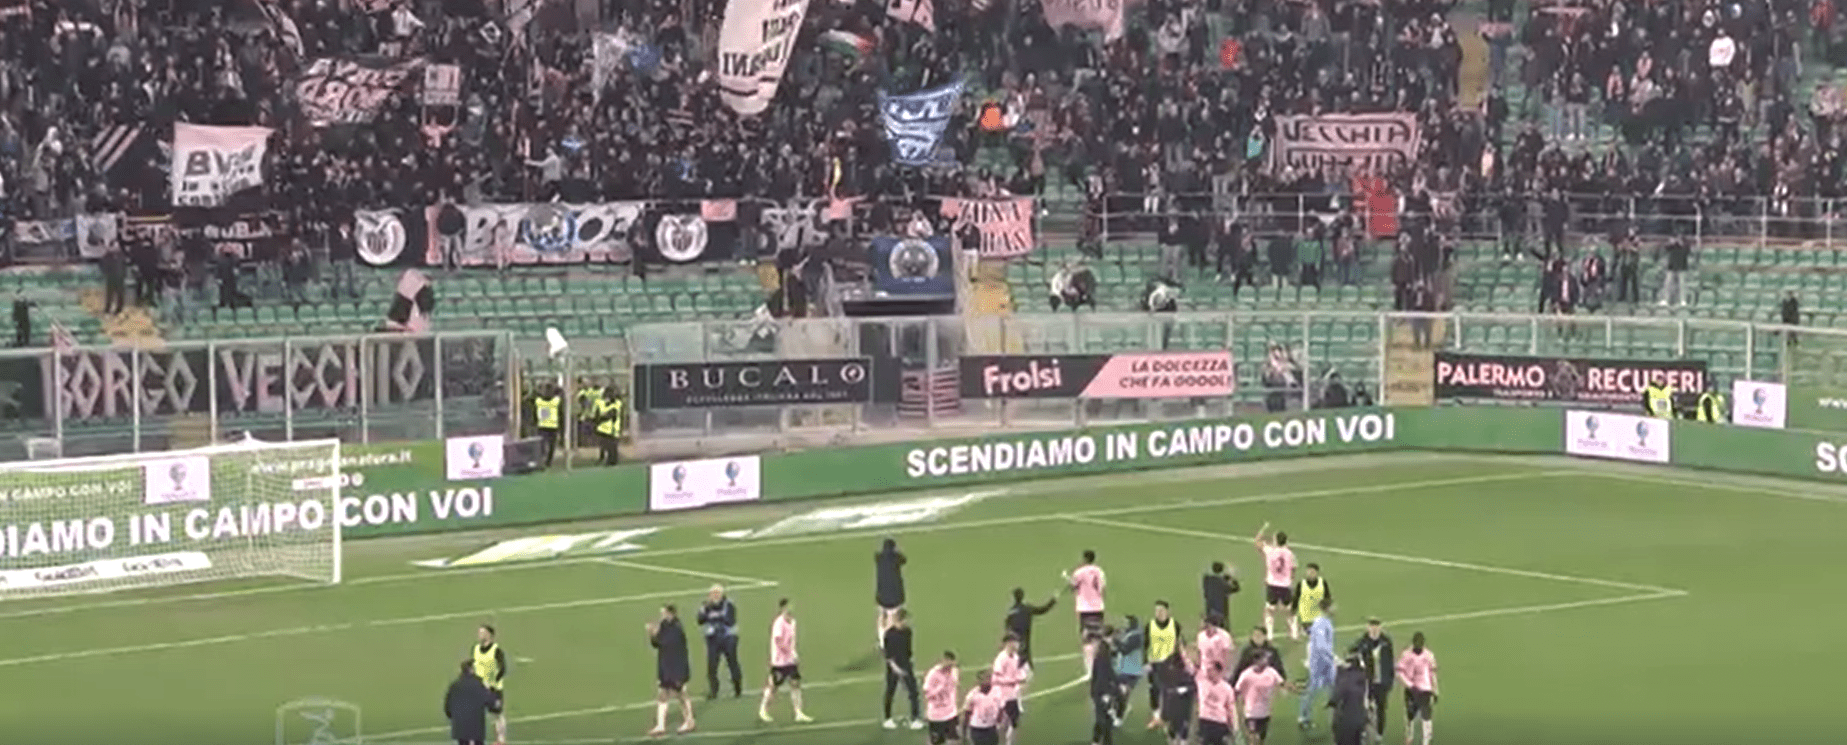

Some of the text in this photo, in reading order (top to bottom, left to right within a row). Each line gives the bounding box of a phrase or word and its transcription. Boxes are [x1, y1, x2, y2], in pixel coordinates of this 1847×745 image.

[40, 340, 424, 419] BORGO VECCHIO
[669, 364, 865, 389] BUCALO
[983, 358, 1062, 395] Frolsi
[1119, 376, 1147, 389] CHE
[1152, 375, 1171, 388] FA
[1132, 359, 1228, 374] LA DOLCEZZA
[1437, 361, 1703, 394] PALERMO RECUPERI
[907, 413, 1395, 477] SCENDIAMO IN CAMPO CON VOI
[0, 486, 492, 557] IAMO IN CAMPO CON VOI
